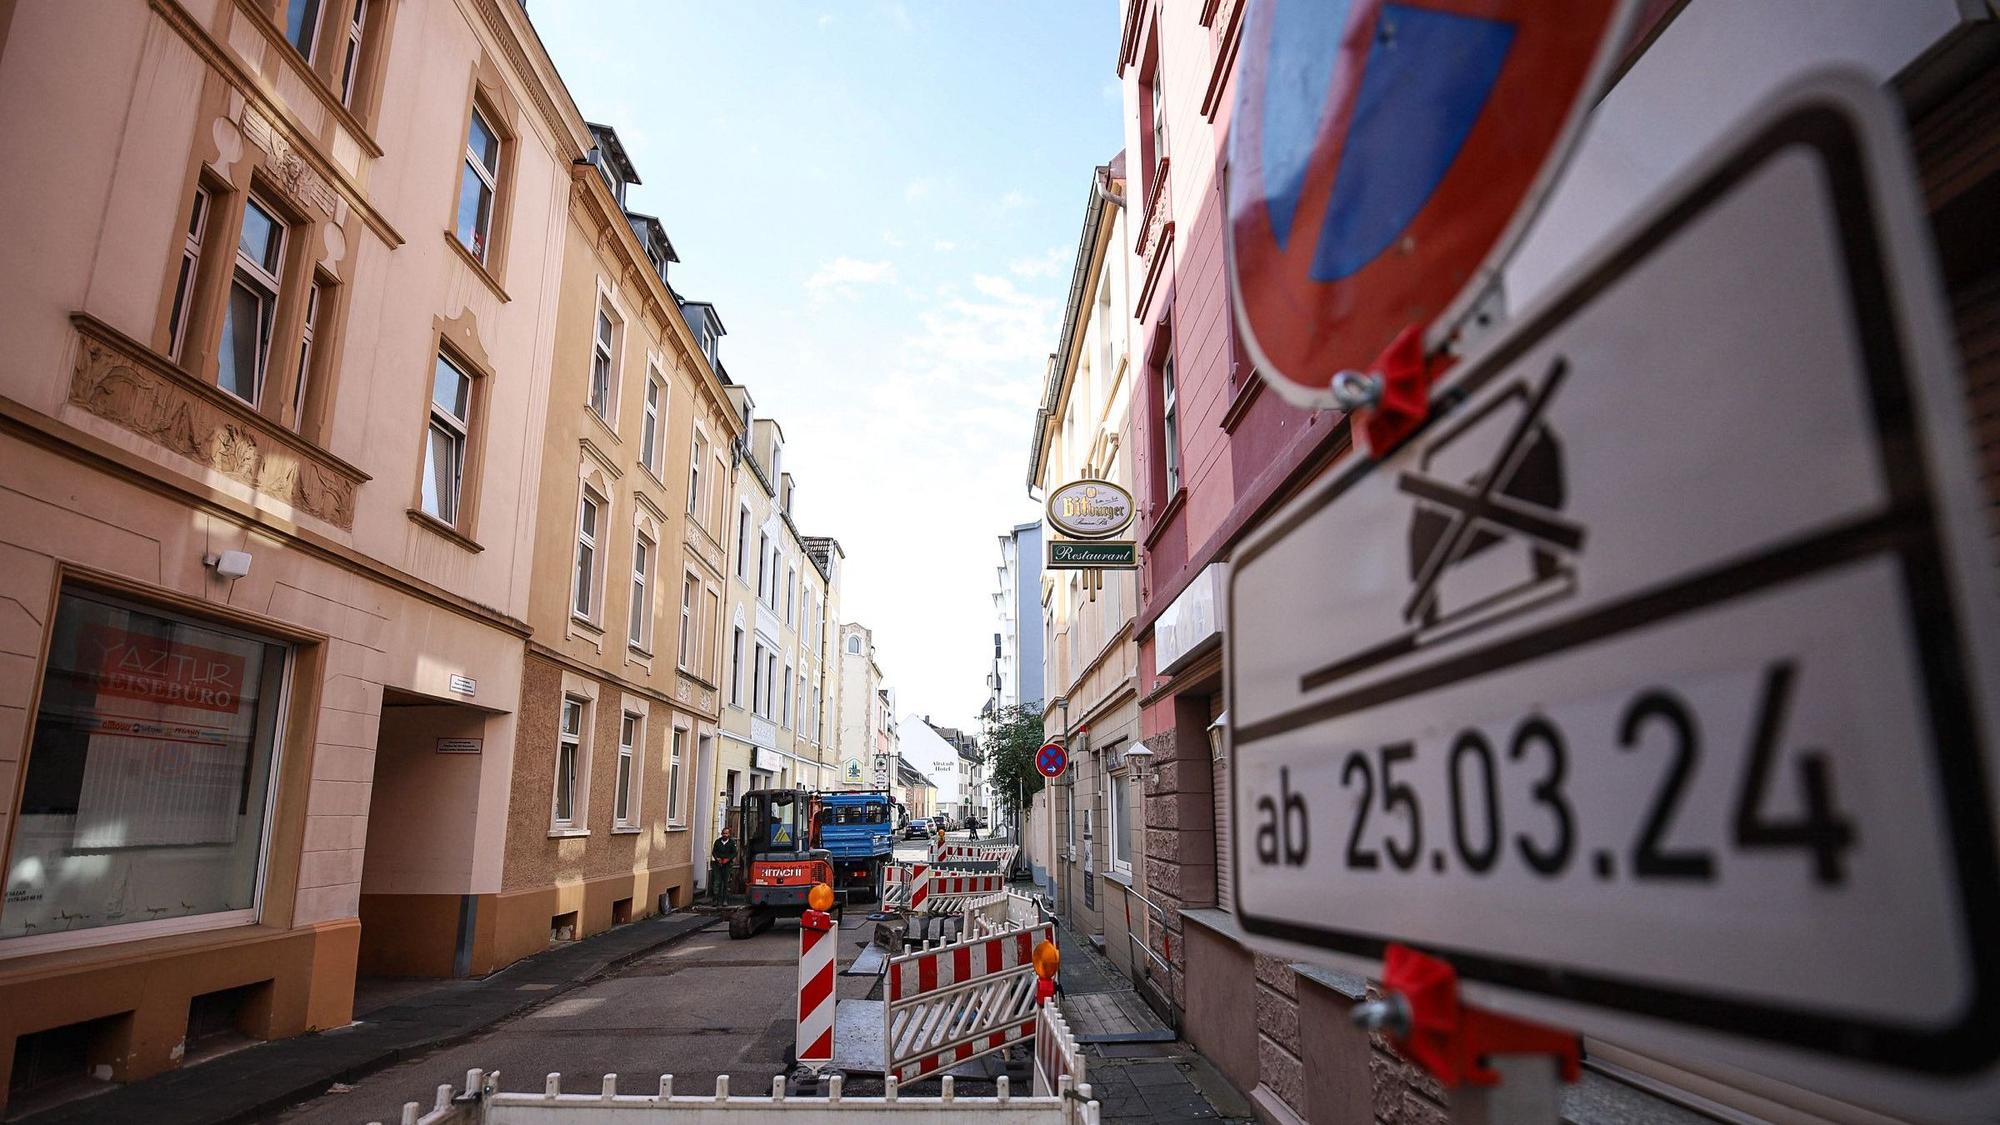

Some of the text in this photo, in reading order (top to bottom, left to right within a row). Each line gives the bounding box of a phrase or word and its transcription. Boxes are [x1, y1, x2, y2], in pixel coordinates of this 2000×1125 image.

[1062, 496, 1125, 520] Bitburger
[1055, 545, 1130, 561] Restaurant
[93, 637, 233, 688] YAZTUR
[1255, 765, 1311, 868] ab
[1340, 657, 1858, 888] 25.03.24
[761, 868, 802, 877] HITACHI
